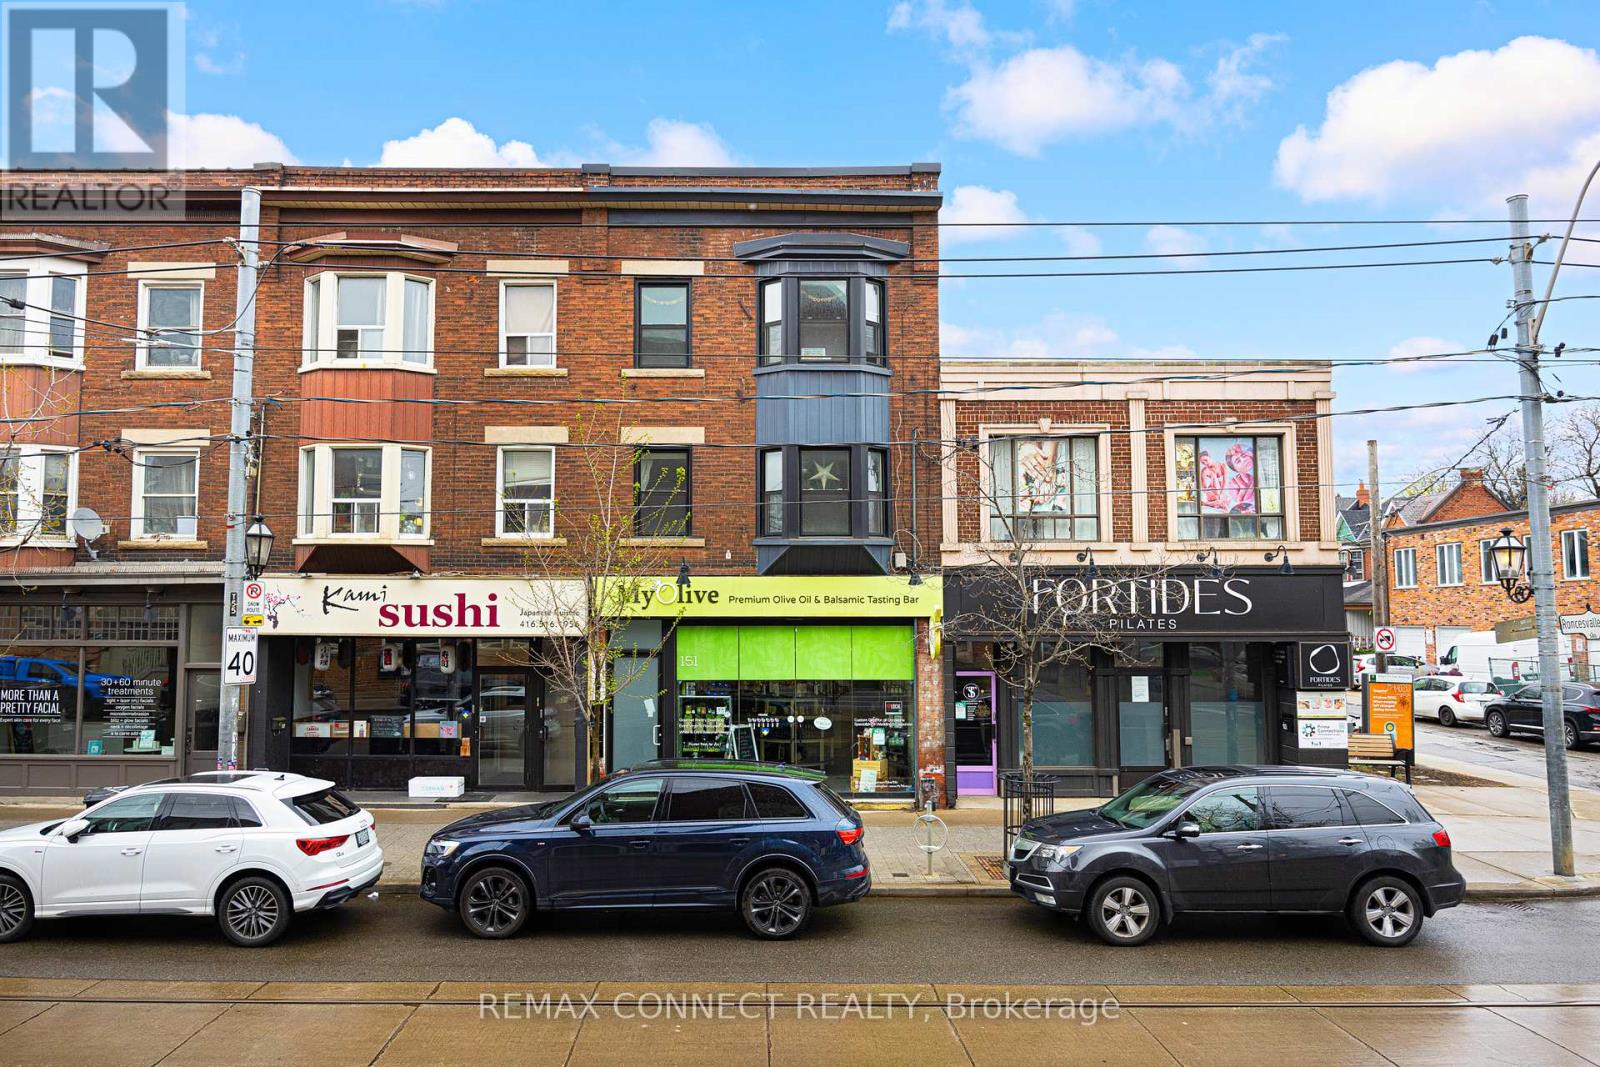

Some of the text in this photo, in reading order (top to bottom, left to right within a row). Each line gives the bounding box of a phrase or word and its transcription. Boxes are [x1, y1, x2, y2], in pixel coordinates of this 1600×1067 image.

[322, 584, 388, 615] Kami
[728, 595, 770, 604] Premium
[773, 595, 797, 604] Olive
[799, 595, 812, 604] Oil
[814, 596, 821, 604] &
[824, 595, 865, 604] Balsamic
[868, 595, 901, 606] Tasting
[903, 595, 919, 604] Bar
[1032, 578, 1253, 616] FORTIDES
[378, 593, 500, 628] sushi
[1109, 618, 1177, 629] PILATES
[228, 633, 256, 641] MAXIMUM
[227, 651, 254, 676] 40
[680, 655, 698, 666] 151
[132, 678, 162, 686] minute
[1, 690, 59, 701] MORE THAN A
[108, 687, 154, 696] treatments
[0, 702, 61, 713] PRETTY FACIAL
